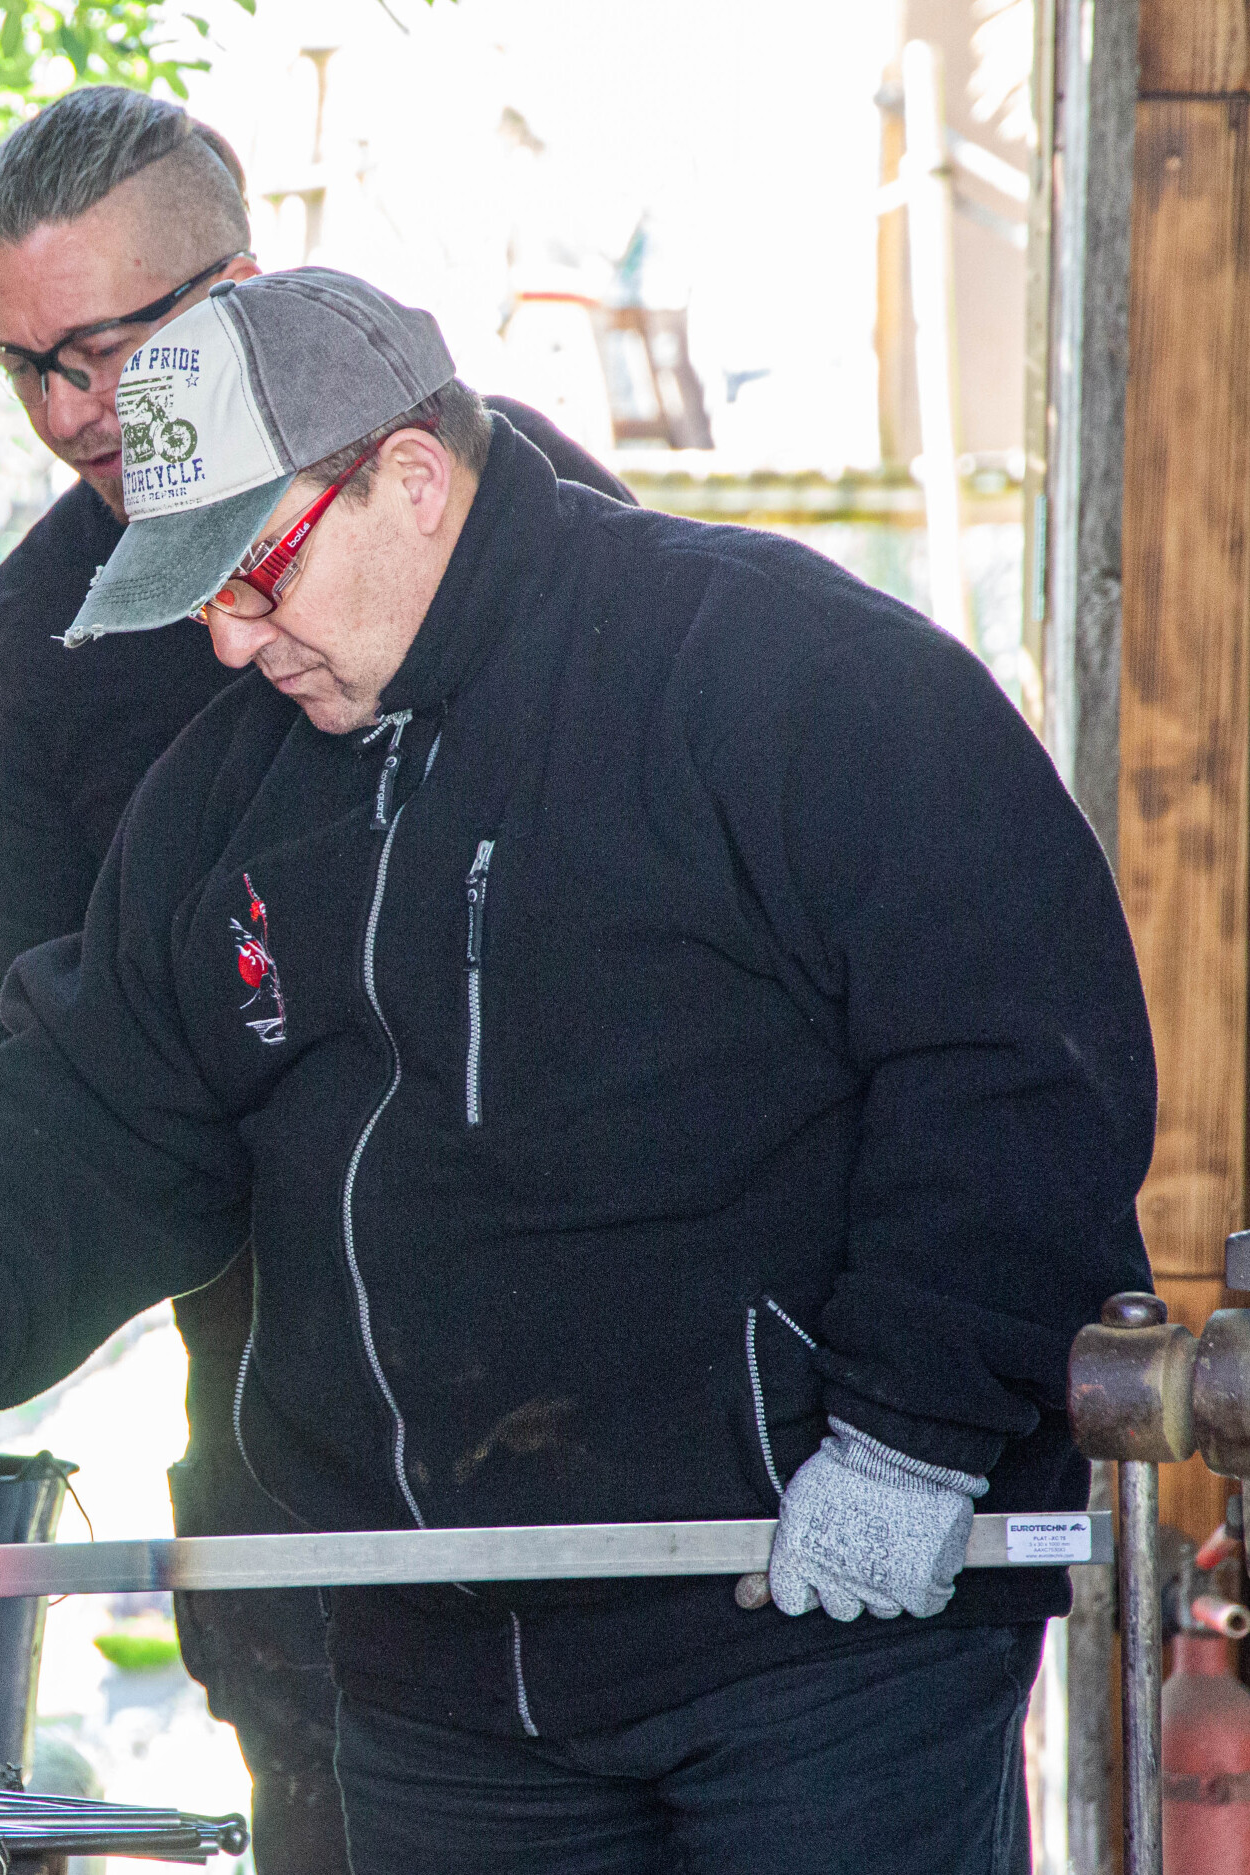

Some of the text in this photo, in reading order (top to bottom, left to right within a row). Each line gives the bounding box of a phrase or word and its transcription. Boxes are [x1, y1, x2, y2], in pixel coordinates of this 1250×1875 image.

[123, 347, 200, 373] N PRIDE
[287, 521, 311, 548] bollé
